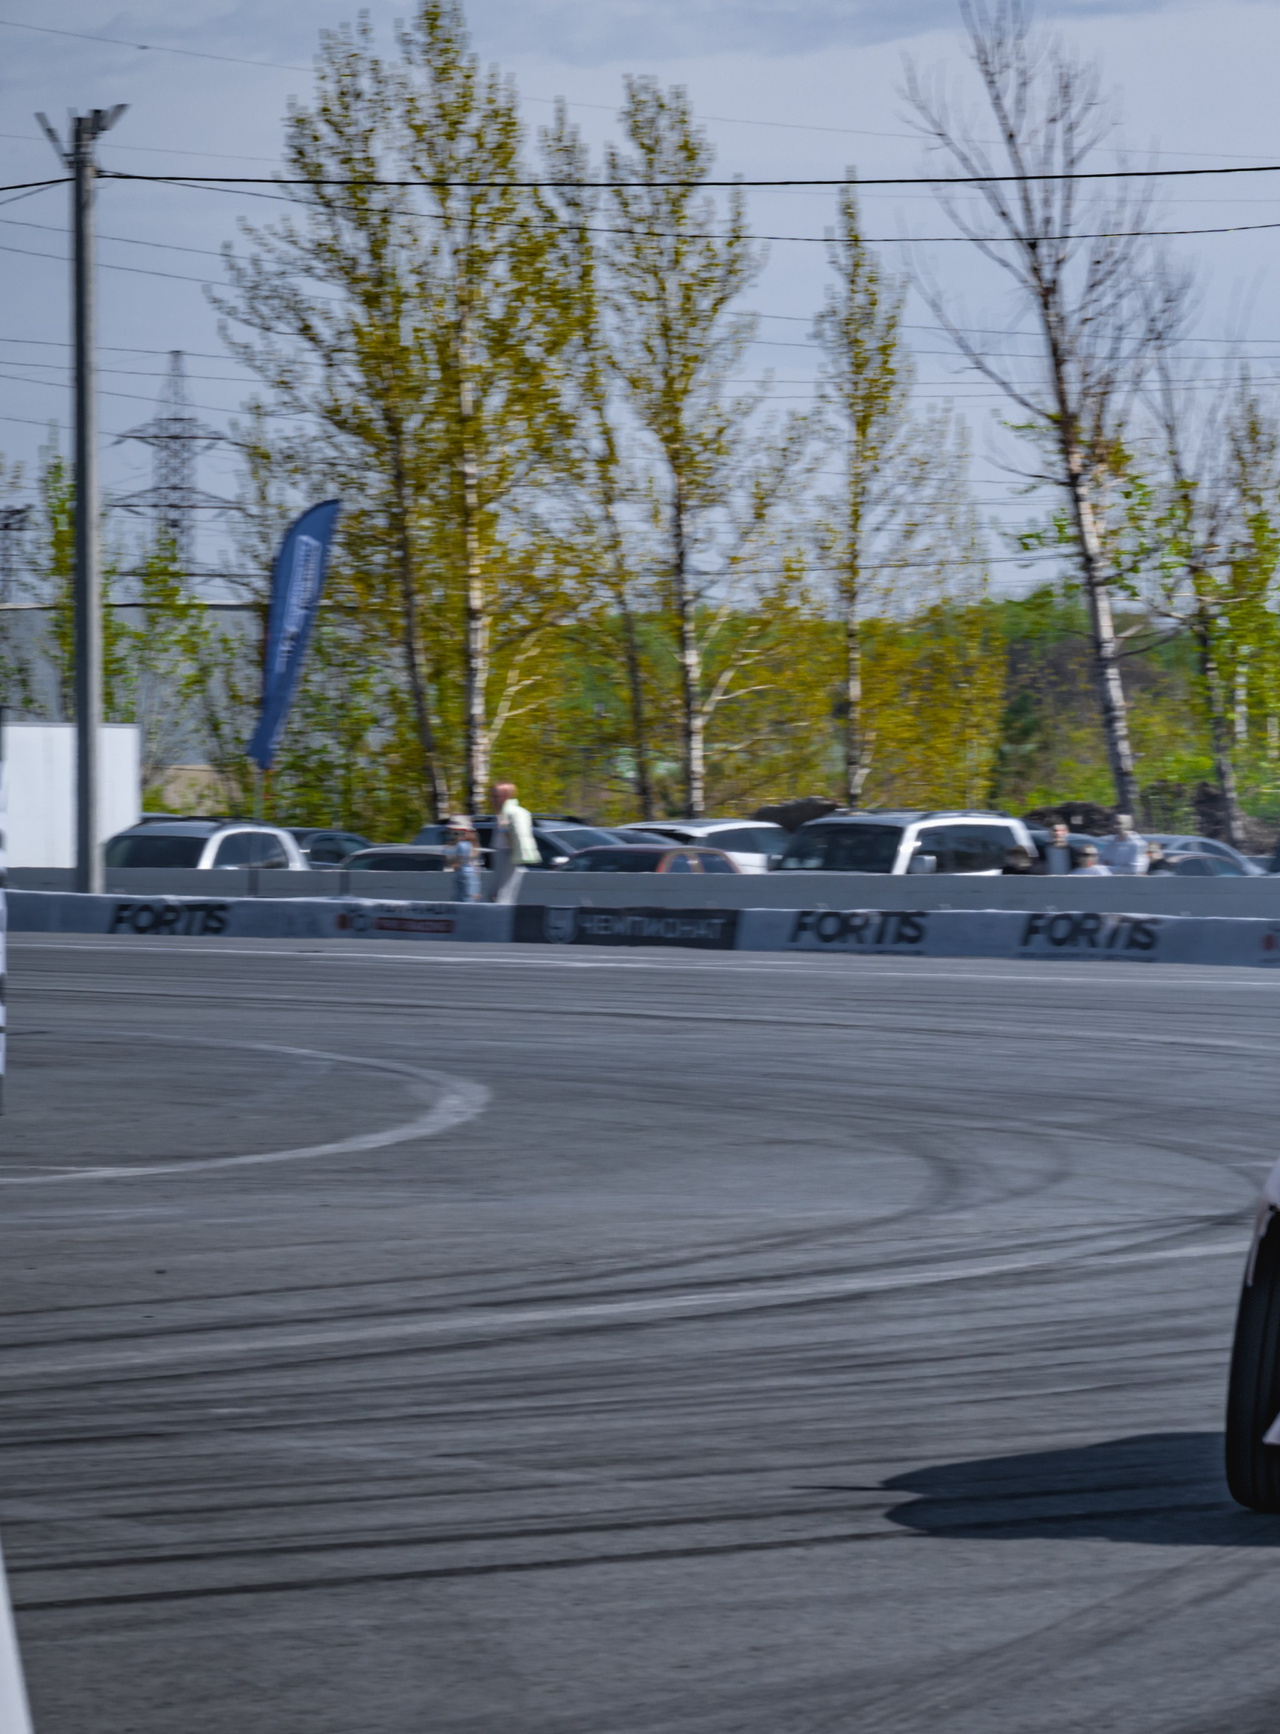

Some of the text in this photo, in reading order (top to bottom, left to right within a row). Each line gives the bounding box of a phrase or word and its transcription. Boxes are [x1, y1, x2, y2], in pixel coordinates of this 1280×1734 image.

[107, 903, 231, 936] FORTIS
[787, 910, 929, 945] FORTIS
[1019, 912, 1160, 951] FORTIS
